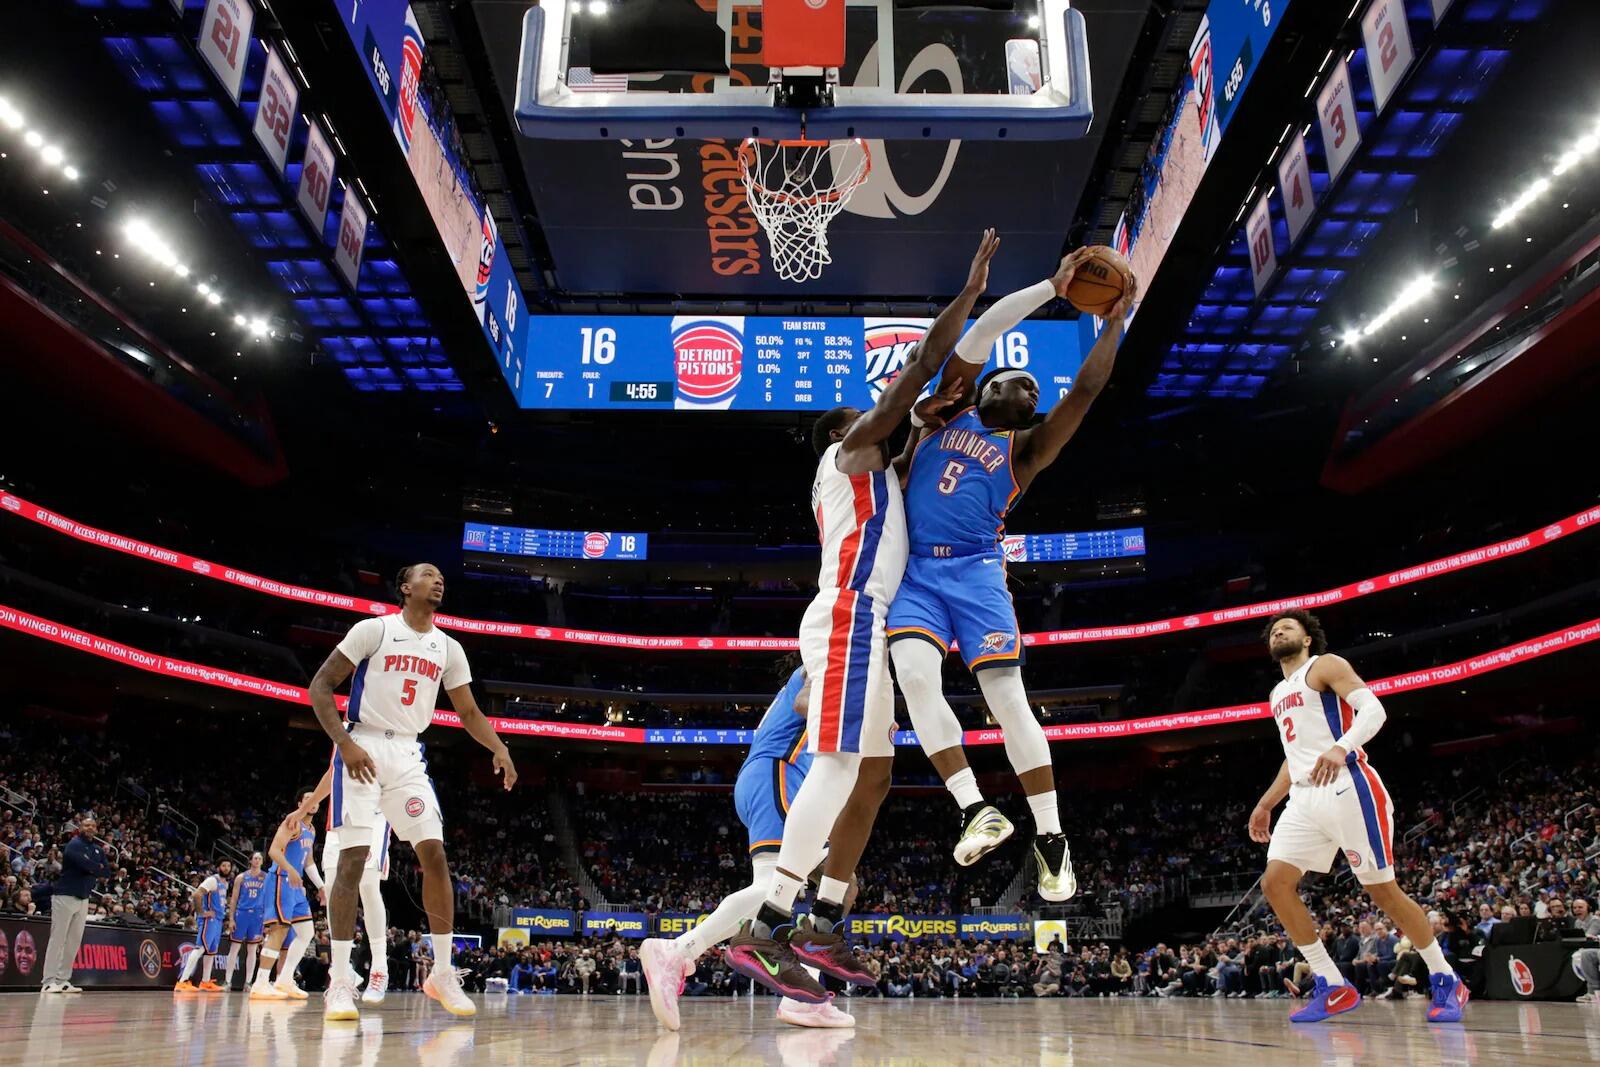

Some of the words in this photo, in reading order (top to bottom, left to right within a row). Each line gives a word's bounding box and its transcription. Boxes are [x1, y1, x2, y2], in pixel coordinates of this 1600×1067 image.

[211, 4, 240, 70] 21
[1378, 22, 1398, 74] 2
[1224, 57, 1244, 101] 4:55
[262, 84, 290, 150] 32
[1330, 104, 1347, 149] 3
[304, 160, 328, 213] 40
[1291, 173, 1304, 210] 4
[1253, 227, 1270, 277] 10
[782, 322, 801, 331] TEAM
[803, 322, 826, 331] STATS
[580, 327, 617, 365] 16
[755, 336, 783, 345] 50.0%
[995, 332, 1029, 369] 16
[678, 349, 734, 362] DETROIT
[757, 349, 781, 360] 0.0%
[797, 352, 810, 360] 3PT
[824, 350, 852, 361] 33.3%
[677, 362, 734, 375] PISTONS
[757, 364, 781, 374] 0.0%
[800, 366, 808, 374] FT
[826, 364, 850, 375] 0.0%
[1054, 376, 1072, 384] FOULS:
[545, 383, 554, 398] 7
[588, 383, 594, 398] 1
[626, 384, 657, 399] 4:55
[765, 379, 772, 389] 2
[835, 379, 842, 389] 0
[765, 392, 772, 402] 5
[940, 429, 1005, 472] THUNDER
[938, 459, 966, 495] 5
[36, 510, 48, 521] GET
[48, 513, 74, 532] PRIORITY
[74, 526, 96, 540] ACCESS
[97, 533, 109, 544] FOR
[109, 537, 136, 551] STANLEY
[137, 544, 149, 555] CUP
[150, 547, 178, 563] PLAYOFFS
[933, 546, 952, 557] OKC
[1389, 574, 1400, 584] GET
[1400, 567, 1426, 581] PRIORITY
[1427, 561, 1447, 573] ACCESS
[1448, 557, 1460, 567] FOR
[1461, 550, 1486, 564] STANLEY
[1487, 546, 1500, 557] CUP
[1500, 538, 1530, 554] PLAYOFFS
[224, 570, 236, 580] GET
[236, 573, 260, 588] PRIORITY
[261, 580, 279, 592] ACCESS
[280, 584, 290, 594] FOR
[291, 587, 315, 599] STANLEY
[315, 593, 326, 602] CUP
[327, 594, 353, 607] PLAYOFFS
[1213, 613, 1223, 621] GET
[1224, 609, 1249, 620] PRIORITY
[1249, 605, 1269, 616] ACCESS
[1269, 603, 1280, 612] FOR
[1281, 598, 1304, 610] STANLEY
[1304, 597, 1316, 605] CUP
[1316, 590, 1342, 604] PLAYOFFS
[435, 617, 453, 626] ACCESS
[453, 619, 463, 627] FOR
[463, 620, 485, 631] STANLEY
[486, 623, 496, 631] CUP
[497, 624, 521, 634] PLAYOFFS
[1049, 633, 1058, 641] GET
[1058, 631, 1083, 641] PRIORITY
[1083, 629, 1102, 639] ACCESS
[1102, 628, 1112, 638] FOR
[1112, 626, 1135, 637] STANLEY
[1135, 625, 1146, 634] CUP
[1146, 622, 1170, 633] PLAYOFFS
[18, 615, 58, 636] WINGED
[60, 628, 92, 647] WHEEL
[94, 638, 127, 658] NATION
[128, 650, 156, 667] TODAY
[564, 631, 574, 639] GET
[574, 632, 599, 641] PRIORITY
[599, 634, 616, 643] ACCESS
[616, 636, 627, 644] FOR
[627, 637, 648, 646] STANLEY
[648, 638, 659, 646] CUP
[659, 639, 683, 647] PLAYOFFS
[737, 639, 759, 647] PRIORITY
[760, 639, 778, 647] ACCESS
[779, 639, 788, 647] FOR
[384, 655, 442, 682] PISTONS
[1394, 673, 1430, 688] NATION
[1432, 665, 1462, 679] TODAY
[400, 678, 418, 706] 5
[433, 713, 461, 723] NATIO
[1065, 725, 1095, 736] NATION
[1098, 723, 1125, 733] TODAY
[1283, 716, 1296, 743] 2
[978, 732, 997, 740] JOIN
[162, 952, 172, 964] AT
